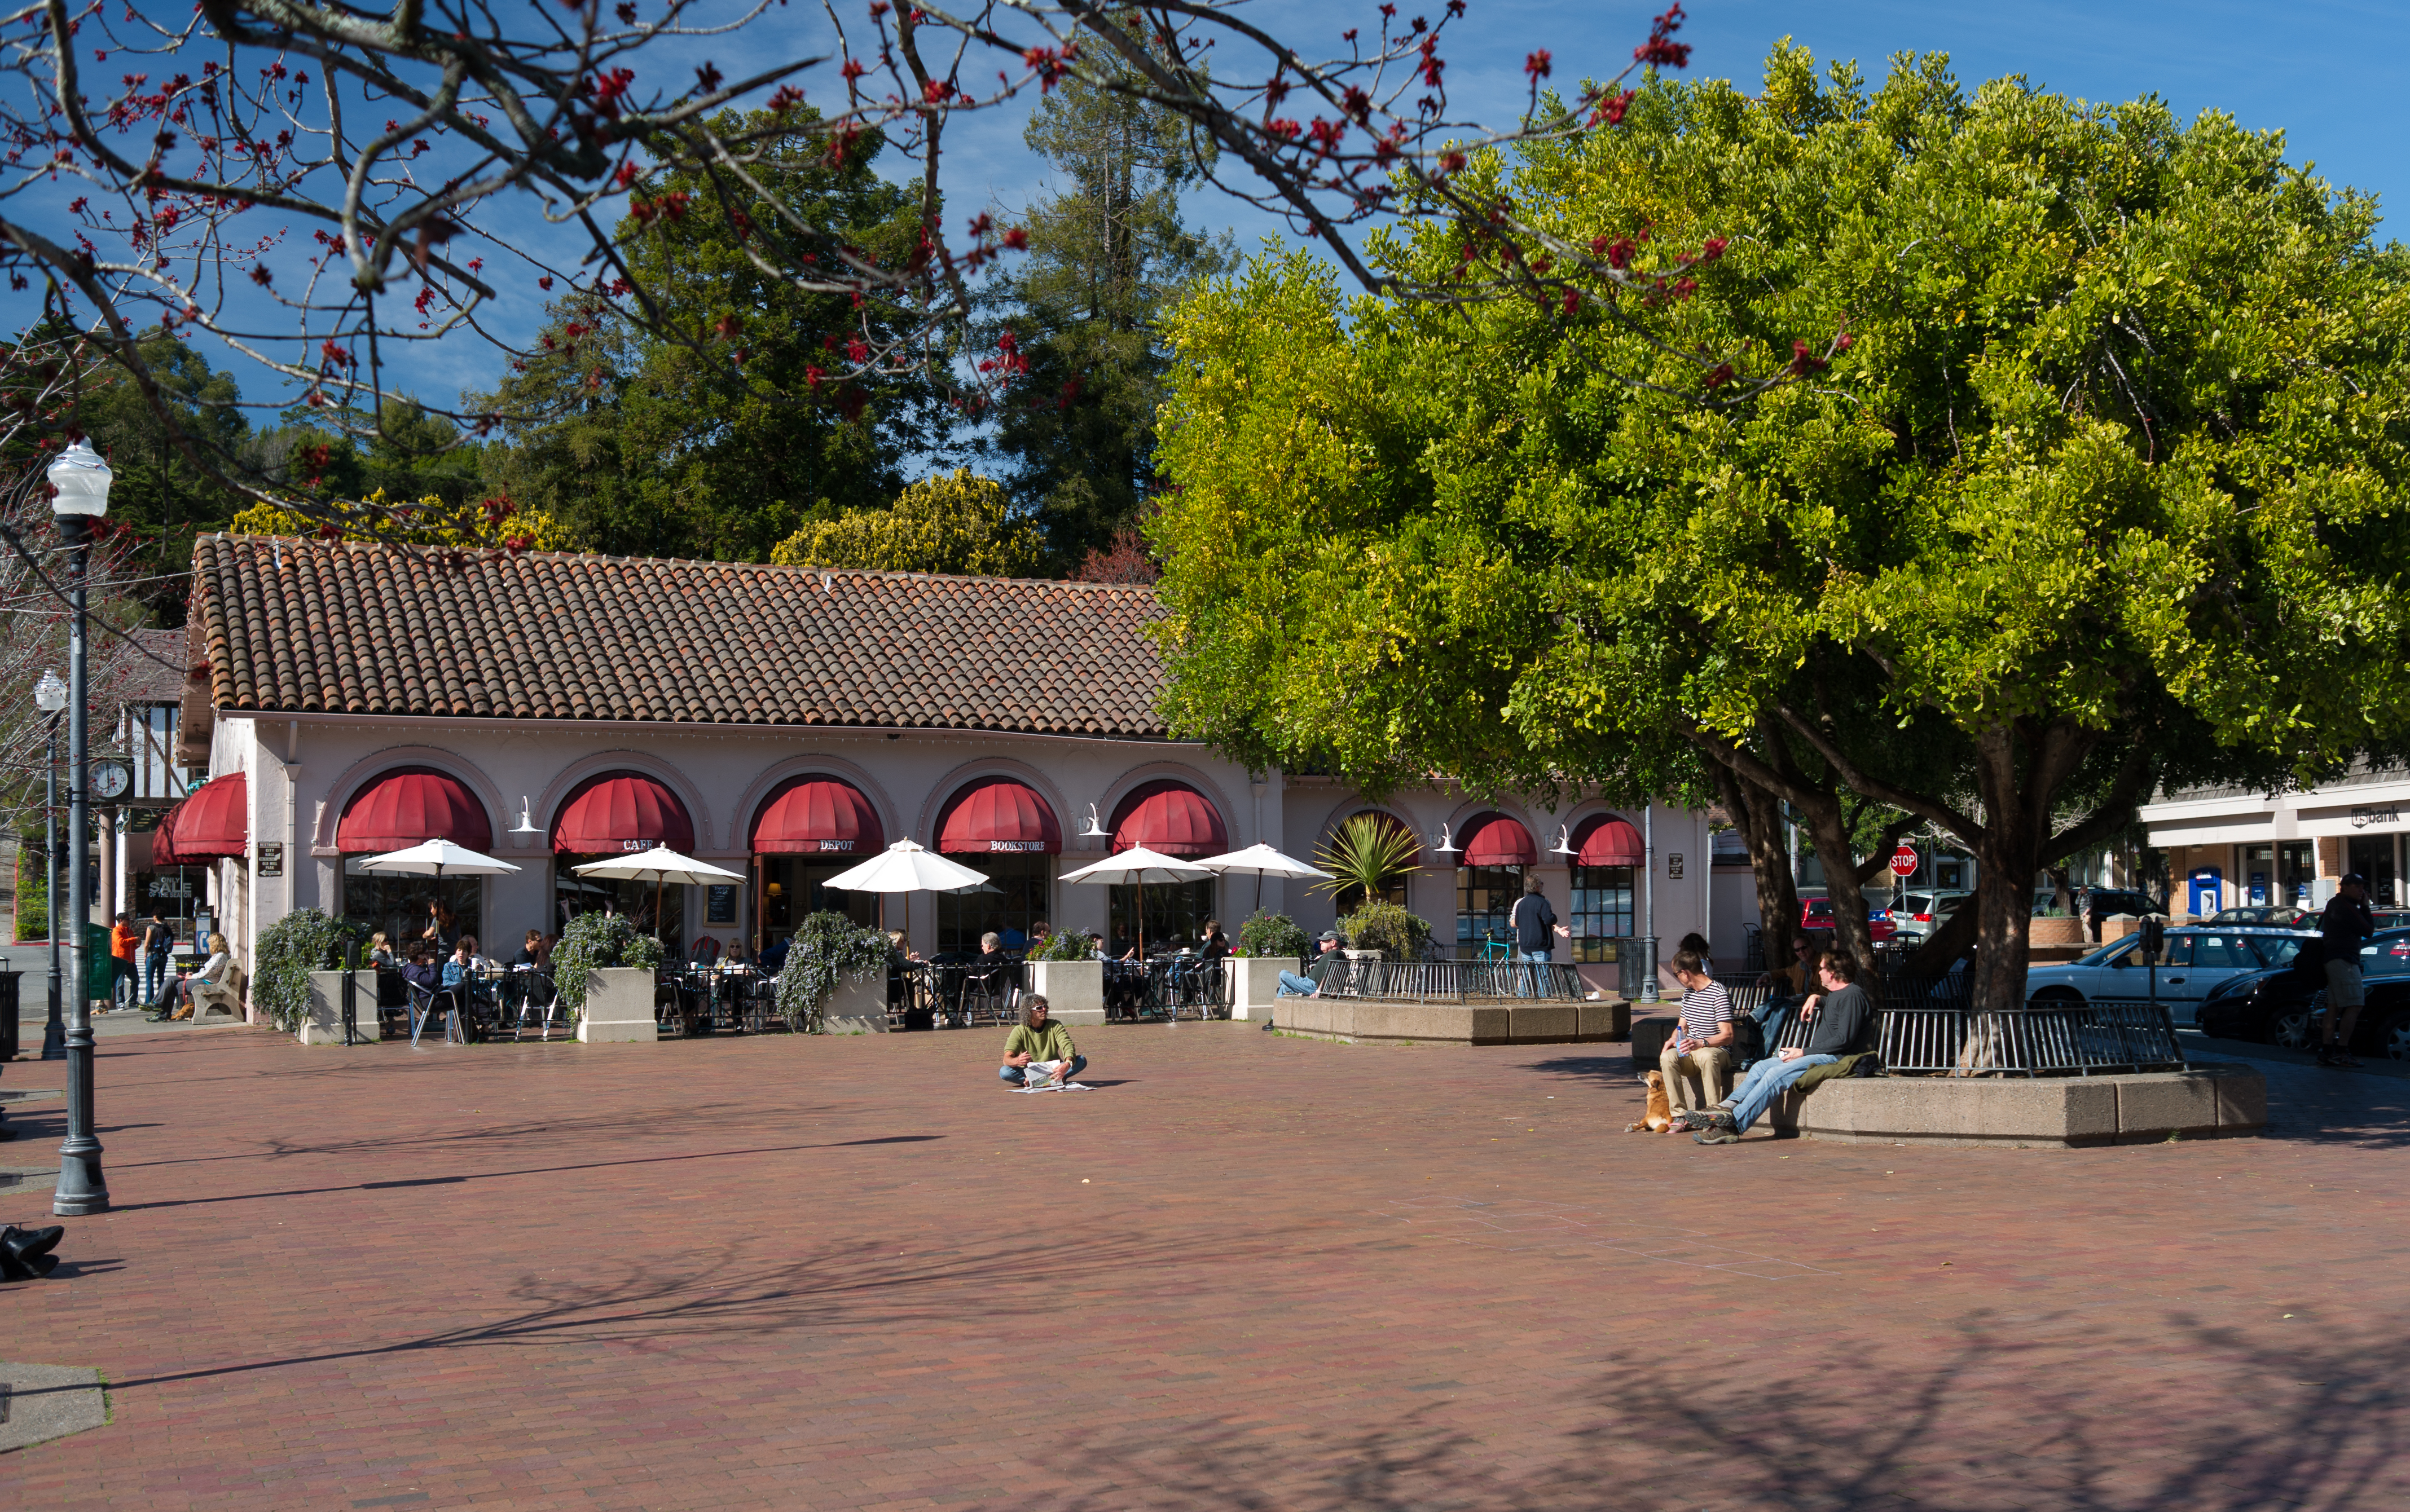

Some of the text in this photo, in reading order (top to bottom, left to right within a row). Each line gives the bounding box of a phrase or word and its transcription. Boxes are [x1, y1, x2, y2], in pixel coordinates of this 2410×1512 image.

[623, 840, 653, 850] CAFE
[820, 840, 854, 850] DEPOT
[991, 841, 1045, 850] BOOKSTORE
[1892, 855, 1915, 867] STOP
[149, 882, 192, 893] SALE
